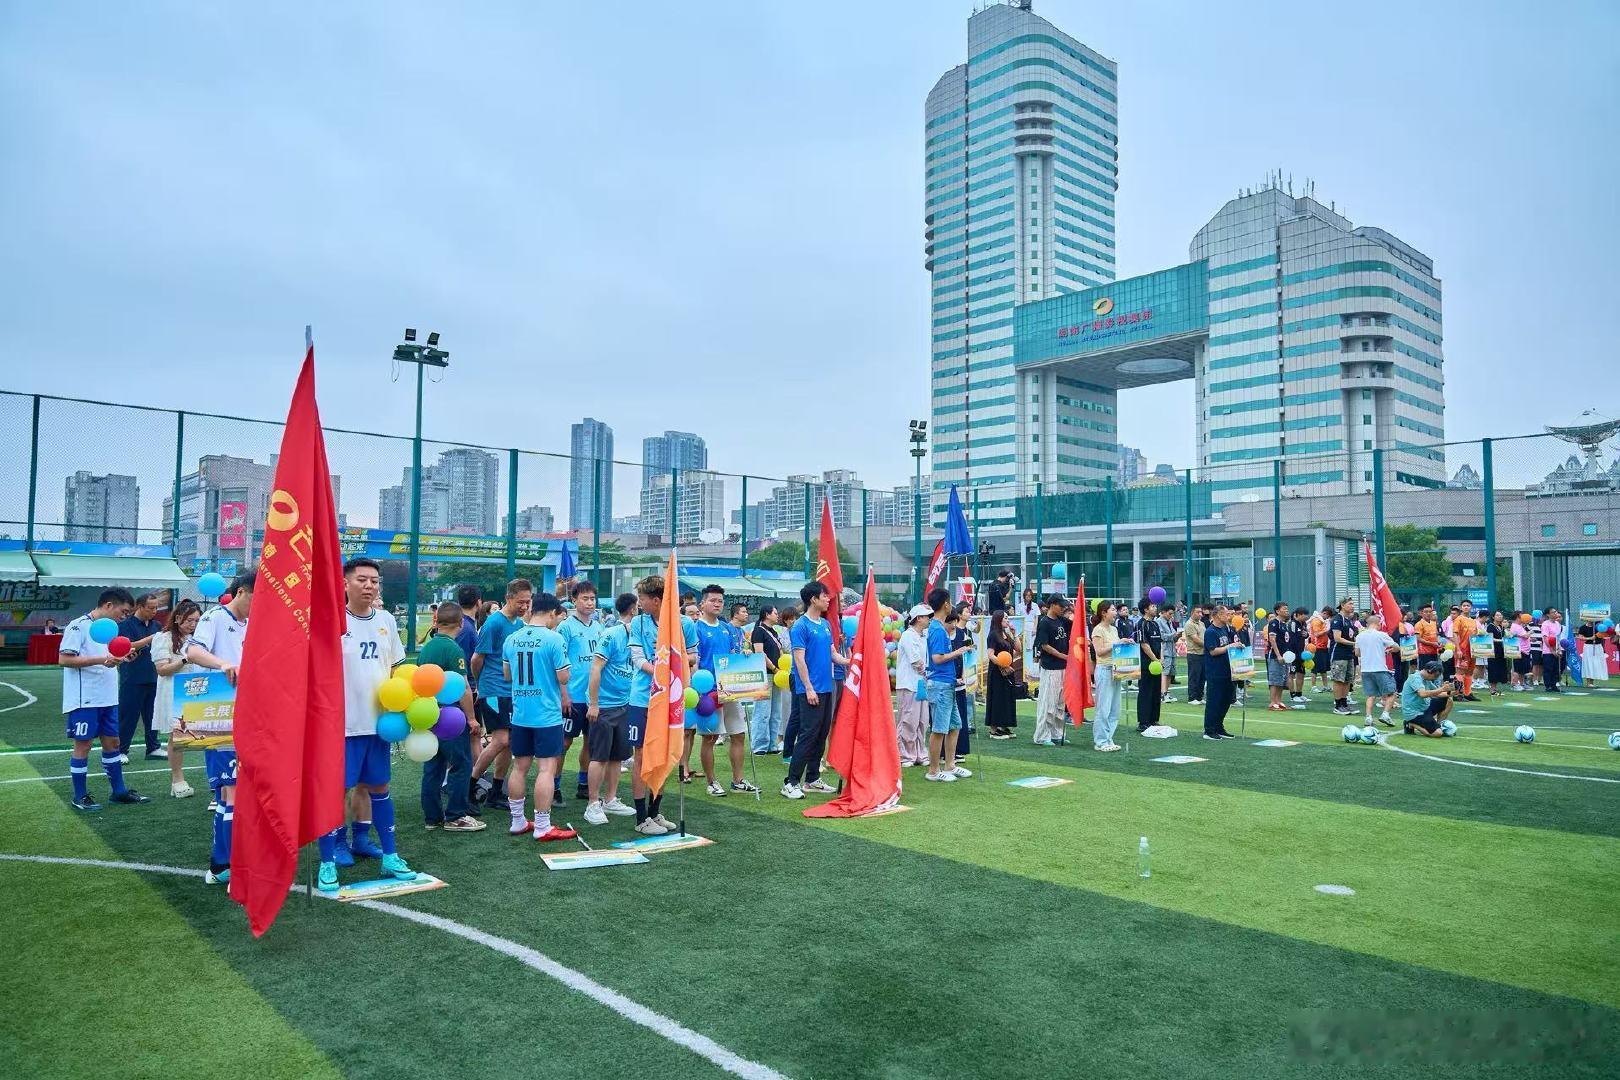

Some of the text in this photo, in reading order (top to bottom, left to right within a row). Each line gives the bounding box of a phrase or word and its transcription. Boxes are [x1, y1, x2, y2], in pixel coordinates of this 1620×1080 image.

[359, 641, 379, 660] 22
[517, 651, 535, 686] 11
[75, 721, 89, 736] 10
